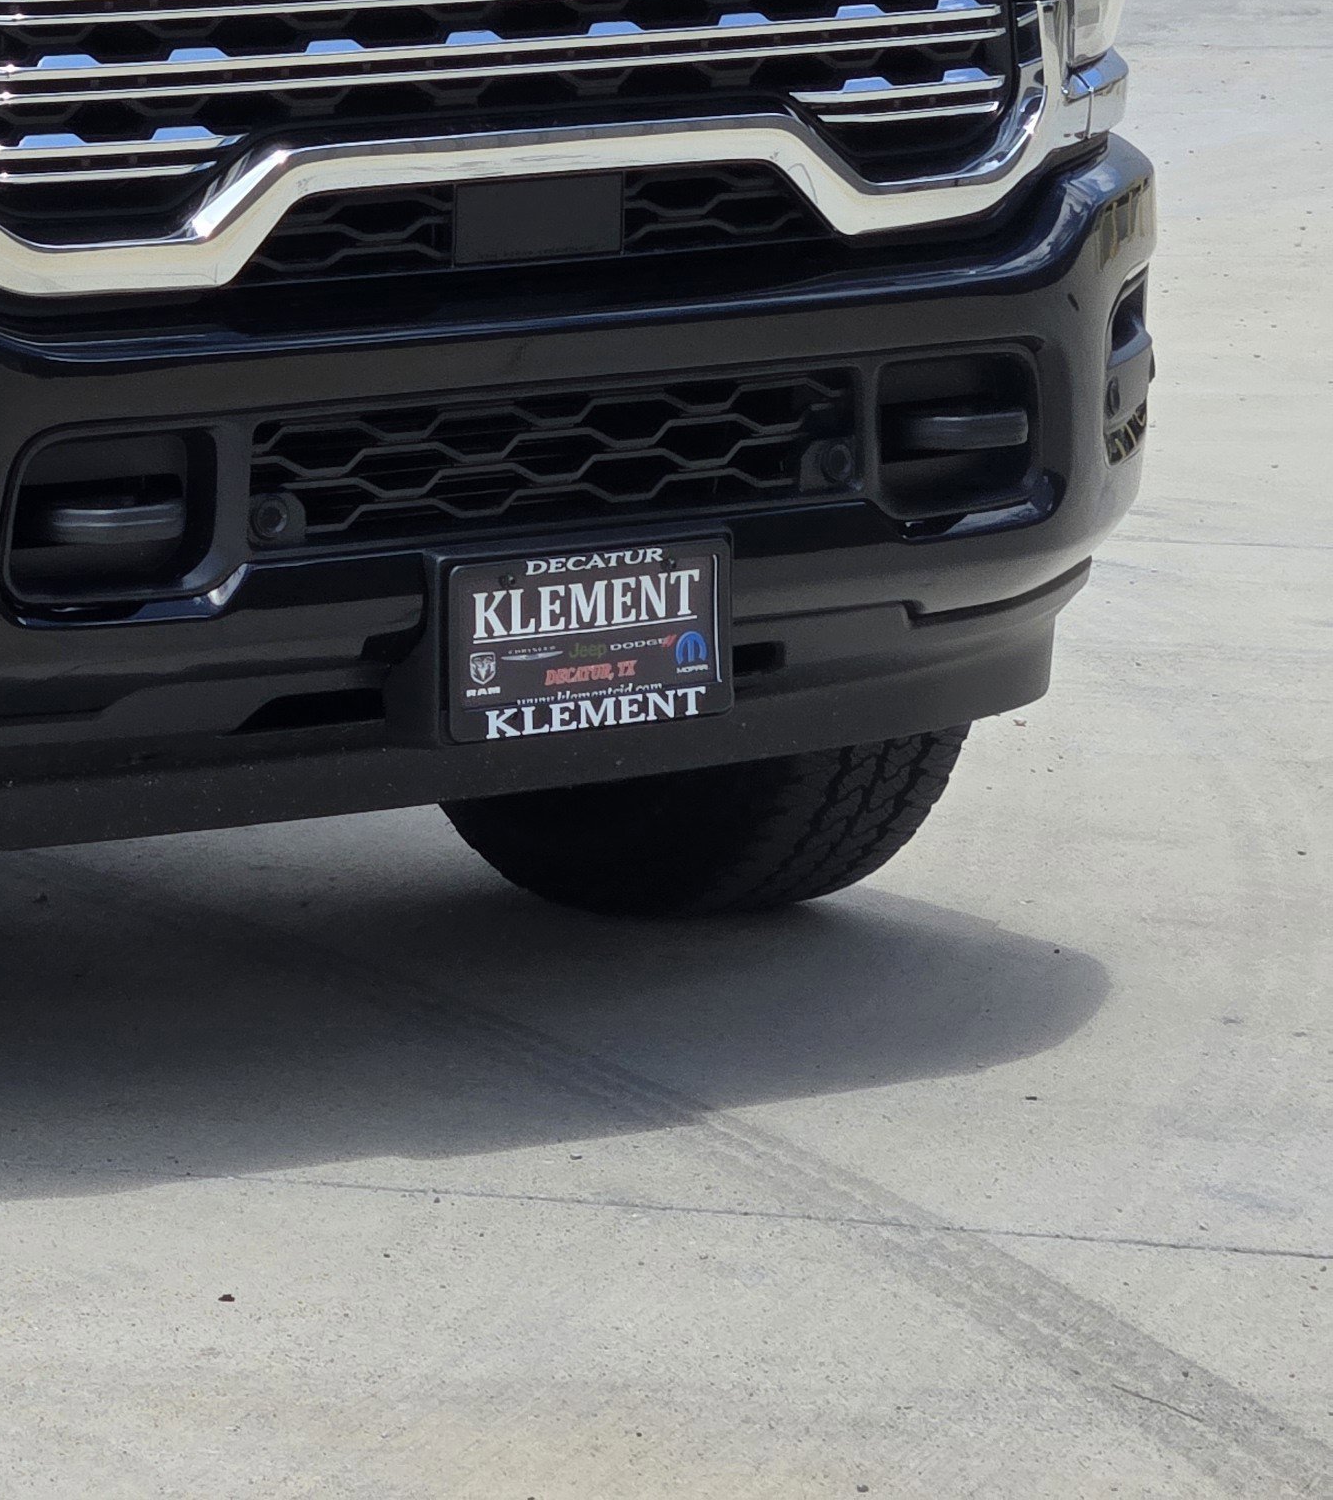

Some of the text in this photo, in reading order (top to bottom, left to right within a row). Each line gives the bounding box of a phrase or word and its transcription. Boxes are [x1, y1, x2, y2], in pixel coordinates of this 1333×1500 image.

[525, 547, 664, 576] DECATUR
[472, 568, 701, 639] KLEMENT
[568, 642, 607, 659] Jeep
[610, 637, 664, 651] DODGE
[616, 659, 637, 677] TX
[466, 686, 501, 698] RAM
[485, 687, 707, 740] KLEMENT
